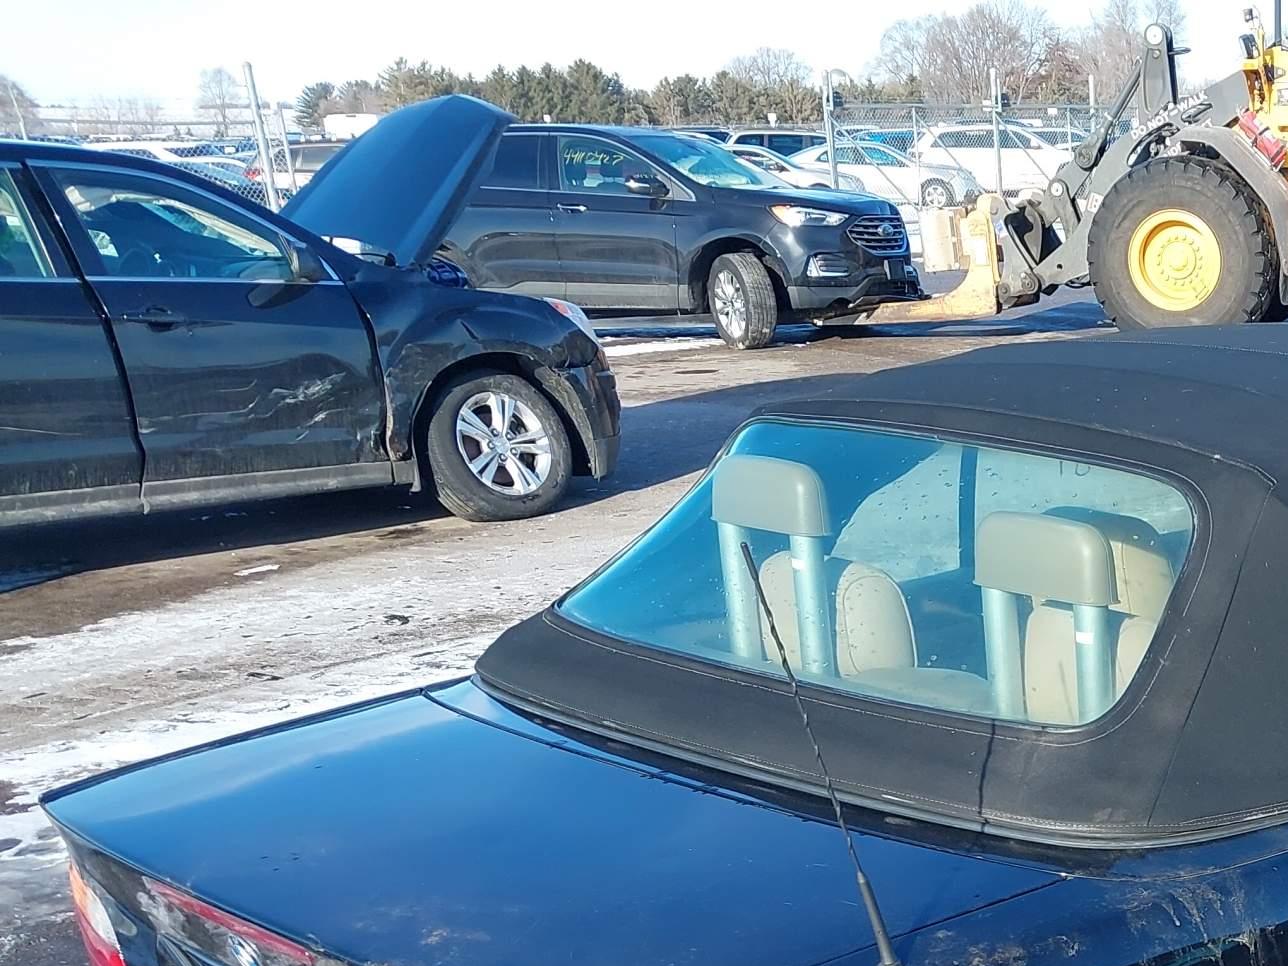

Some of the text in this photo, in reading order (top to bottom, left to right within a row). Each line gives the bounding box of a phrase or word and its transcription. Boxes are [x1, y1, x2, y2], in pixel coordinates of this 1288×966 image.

[1131, 90, 1208, 139] DO NOT WALK
